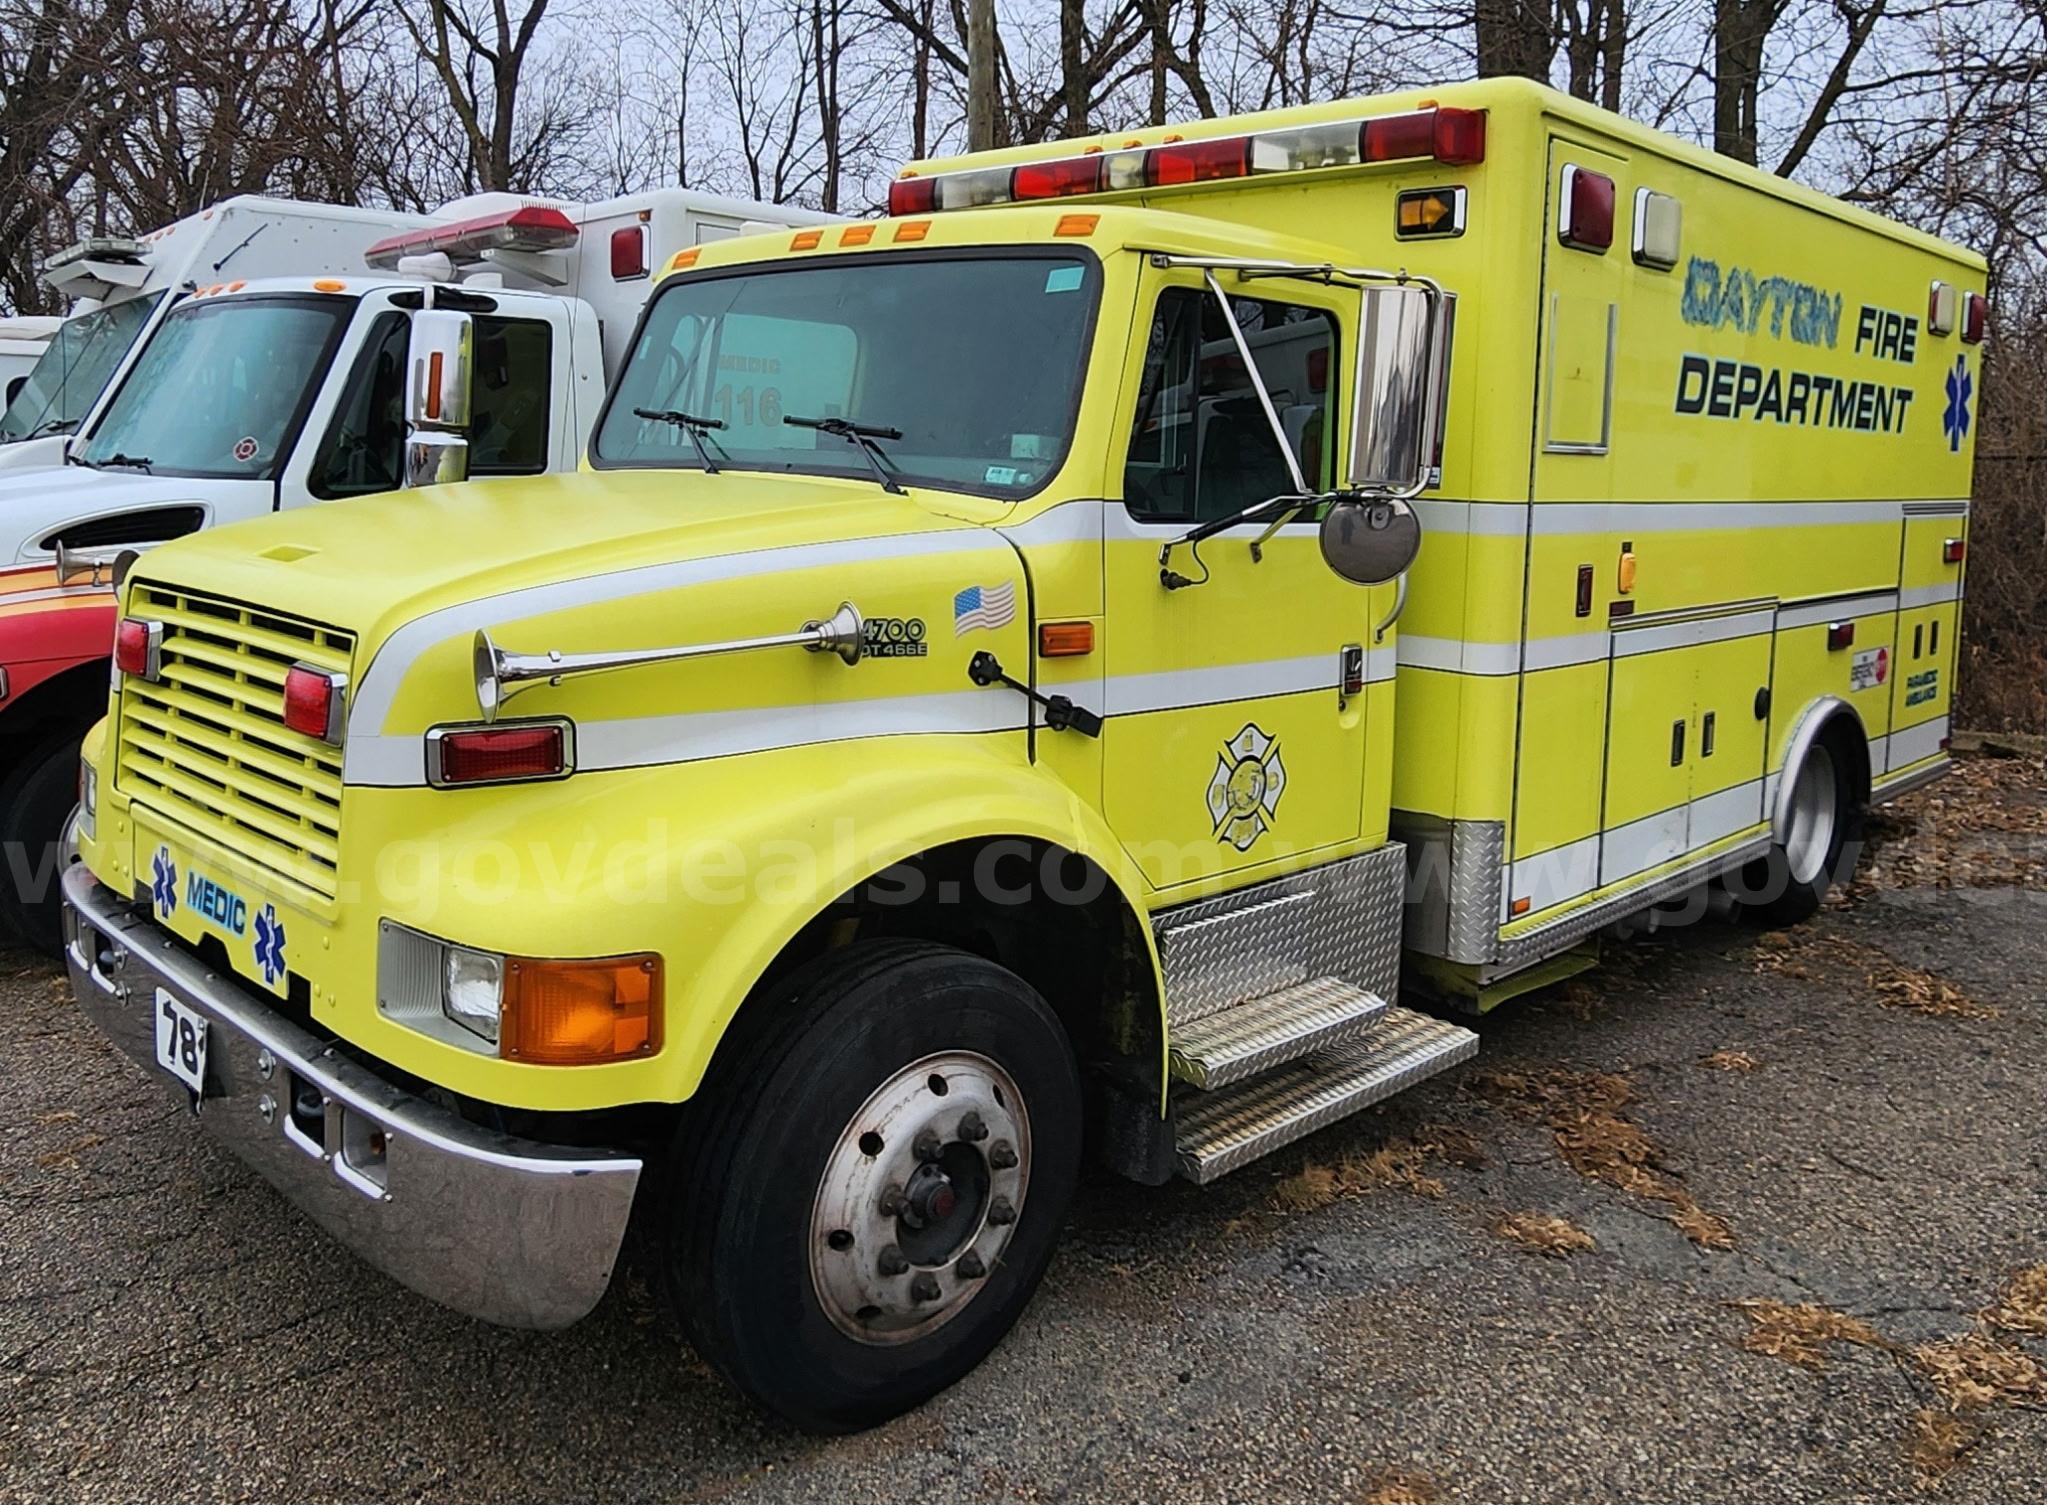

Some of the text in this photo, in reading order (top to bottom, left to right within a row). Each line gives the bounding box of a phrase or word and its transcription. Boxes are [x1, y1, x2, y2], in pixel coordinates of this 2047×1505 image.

[1681, 253, 1919, 364] DAYTON FIRE
[719, 354, 781, 375] MEDIC
[715, 384, 782, 428] 116
[1675, 354, 1914, 434] DEPARTMENT
[863, 618, 926, 641] 4700
[187, 869, 246, 937] MEDIC
